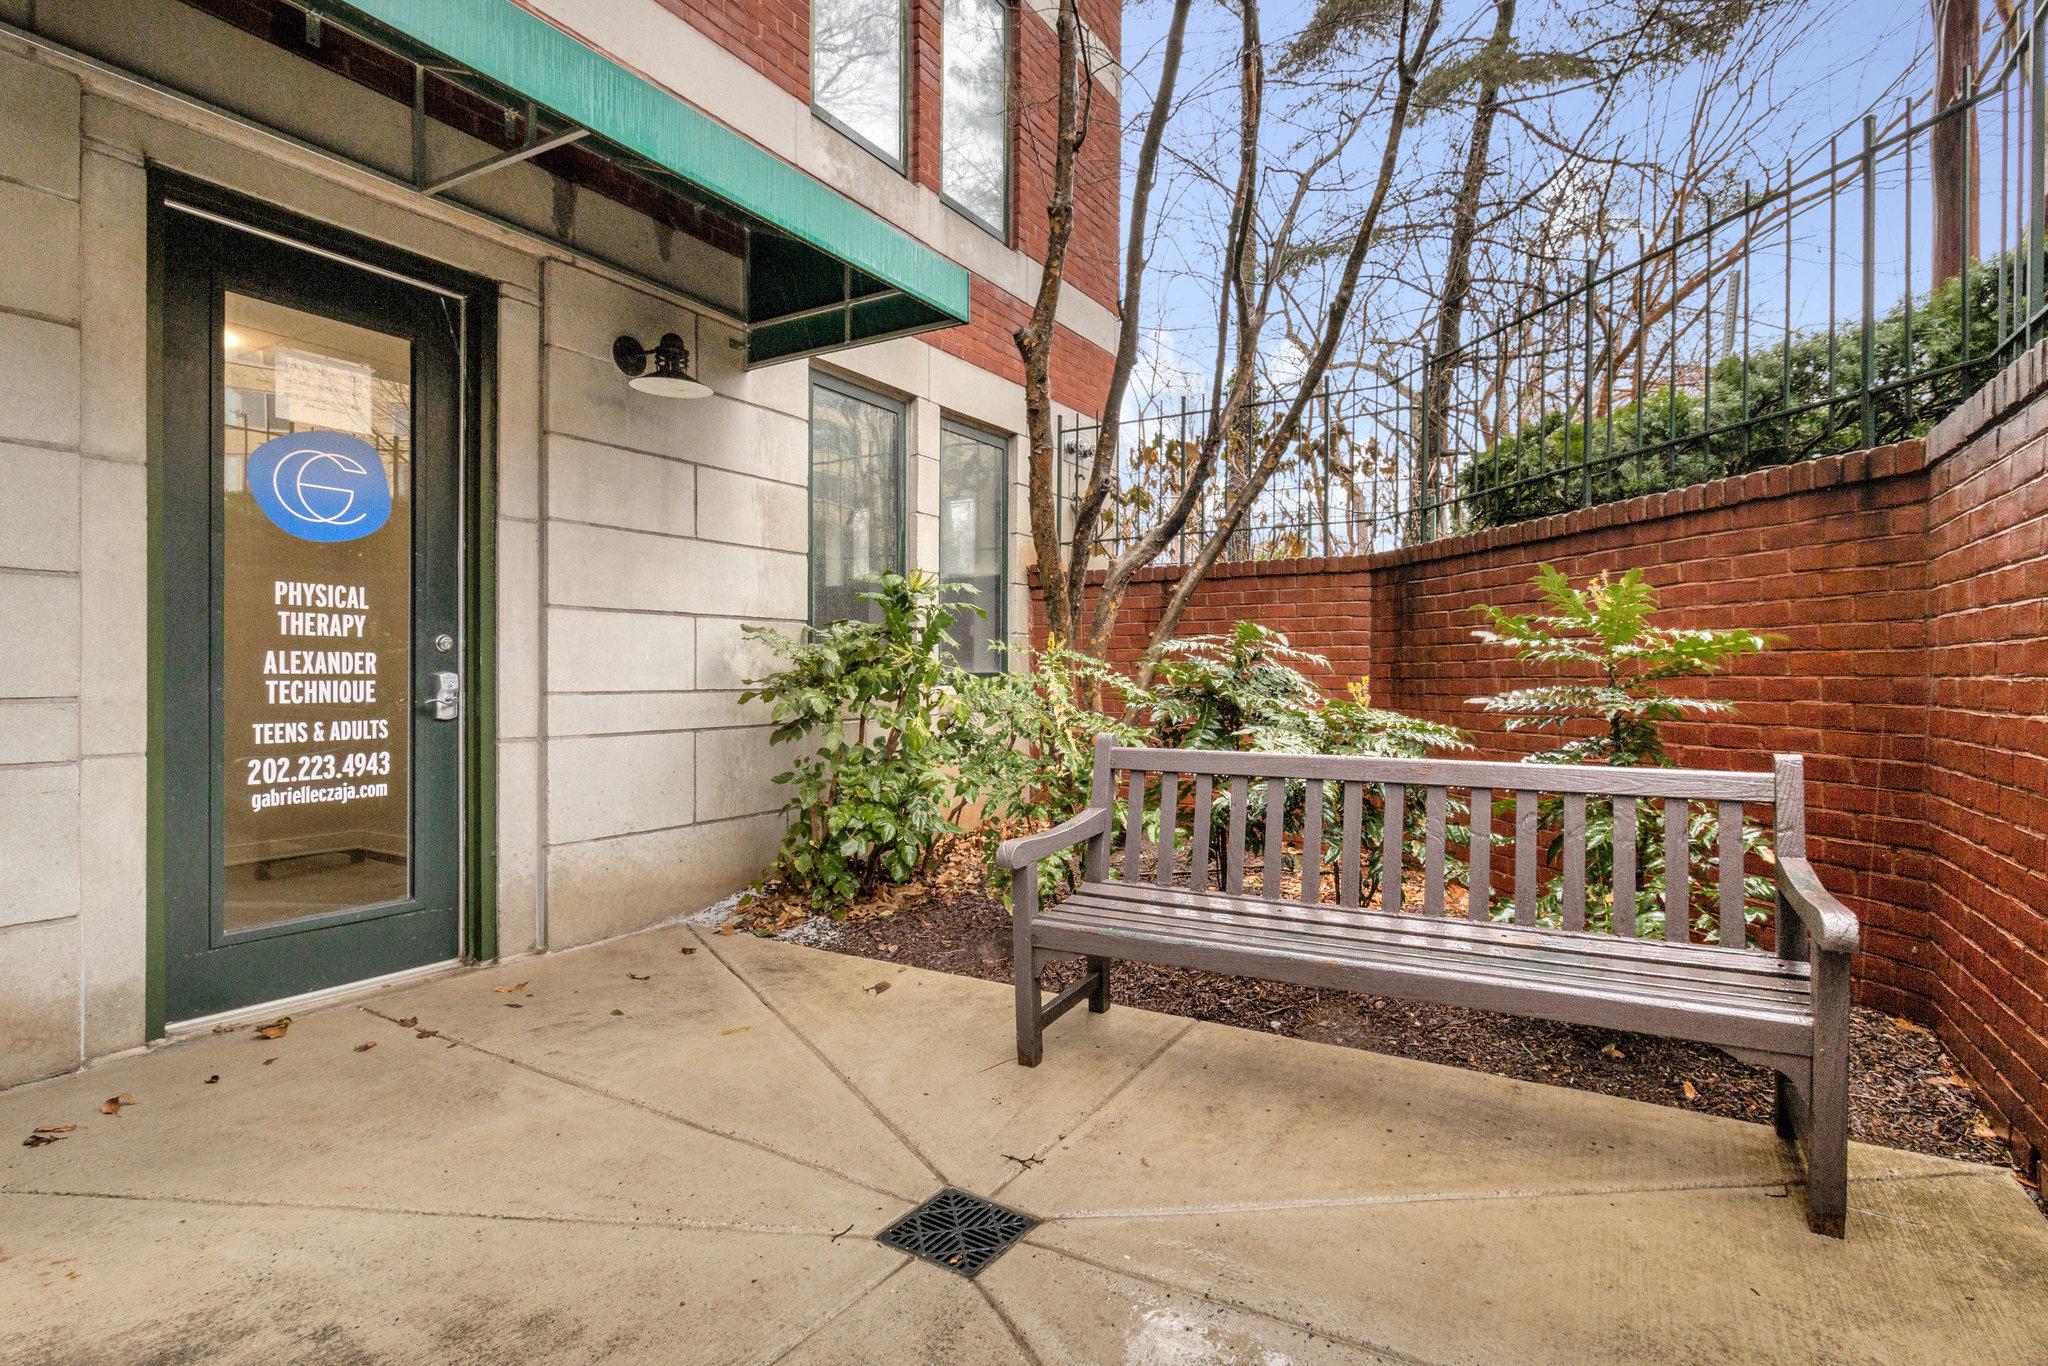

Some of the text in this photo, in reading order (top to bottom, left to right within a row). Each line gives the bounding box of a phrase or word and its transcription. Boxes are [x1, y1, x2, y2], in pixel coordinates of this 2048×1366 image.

[274, 581, 369, 610] PHYSICAL
[278, 611, 366, 637] THERAPY
[263, 650, 377, 675] ALEXANDER
[266, 680, 376, 704] TECHNIQUE
[252, 719, 389, 745] TEENS & ADULTS
[247, 751, 390, 785] 202.223.4943
[251, 781, 388, 812] gabrielleczaja.com
